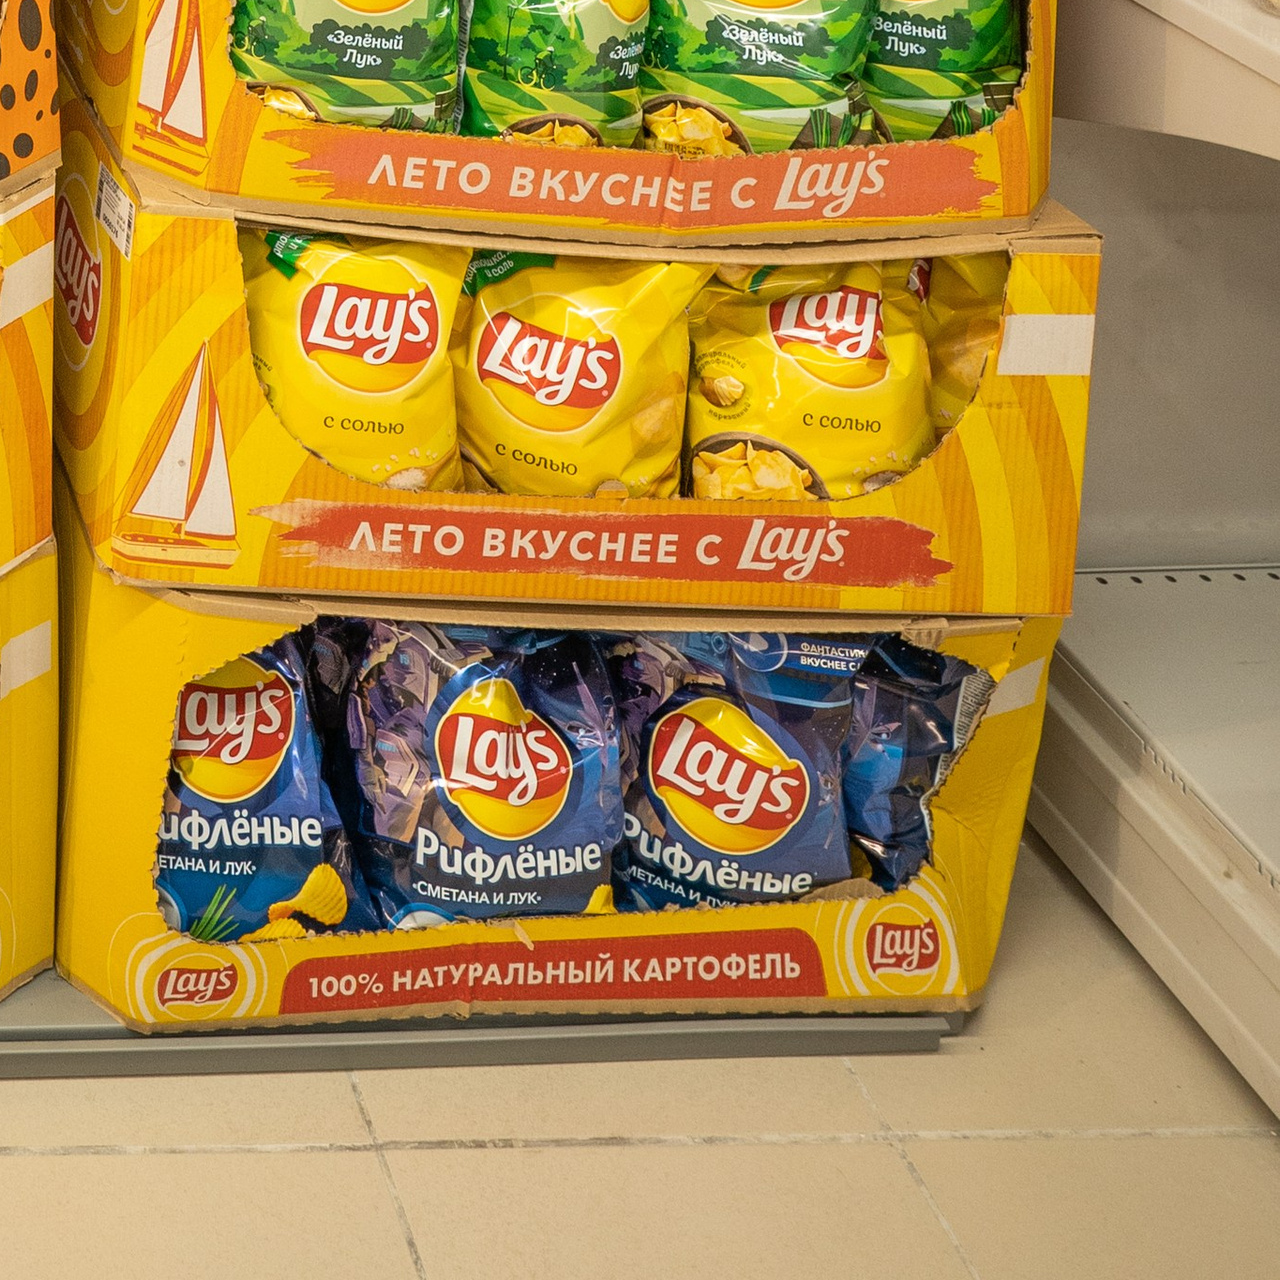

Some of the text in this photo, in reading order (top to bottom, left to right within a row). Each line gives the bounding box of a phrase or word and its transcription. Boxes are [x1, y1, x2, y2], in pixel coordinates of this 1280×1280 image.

[327, 28, 404, 52] «Зелёный
[722, 24, 804, 49] «Зелёный
[885, 36, 927, 56] Лук»
[343, 47, 383, 67] Лук»
[368, 153, 889, 221] ЛЕТО ВКУСНЕЕ С Lay's
[323, 416, 404, 436] с солью
[802, 412, 881, 434] с солью
[494, 442, 578, 477] с солью
[348, 518, 849, 581] ЛЕТО ВКУСНЕЕ С Lay's
[656, 718, 800, 825] Lay's
[209, 858, 257, 875] И ЛУК»
[416, 826, 602, 885] Рифлёные
[412, 879, 541, 905] «СМЕТАНА И ЛУК»
[308, 953, 802, 999] 100% НАТУРАЛЬНЫЙ КАРТОФЕЛЬ
